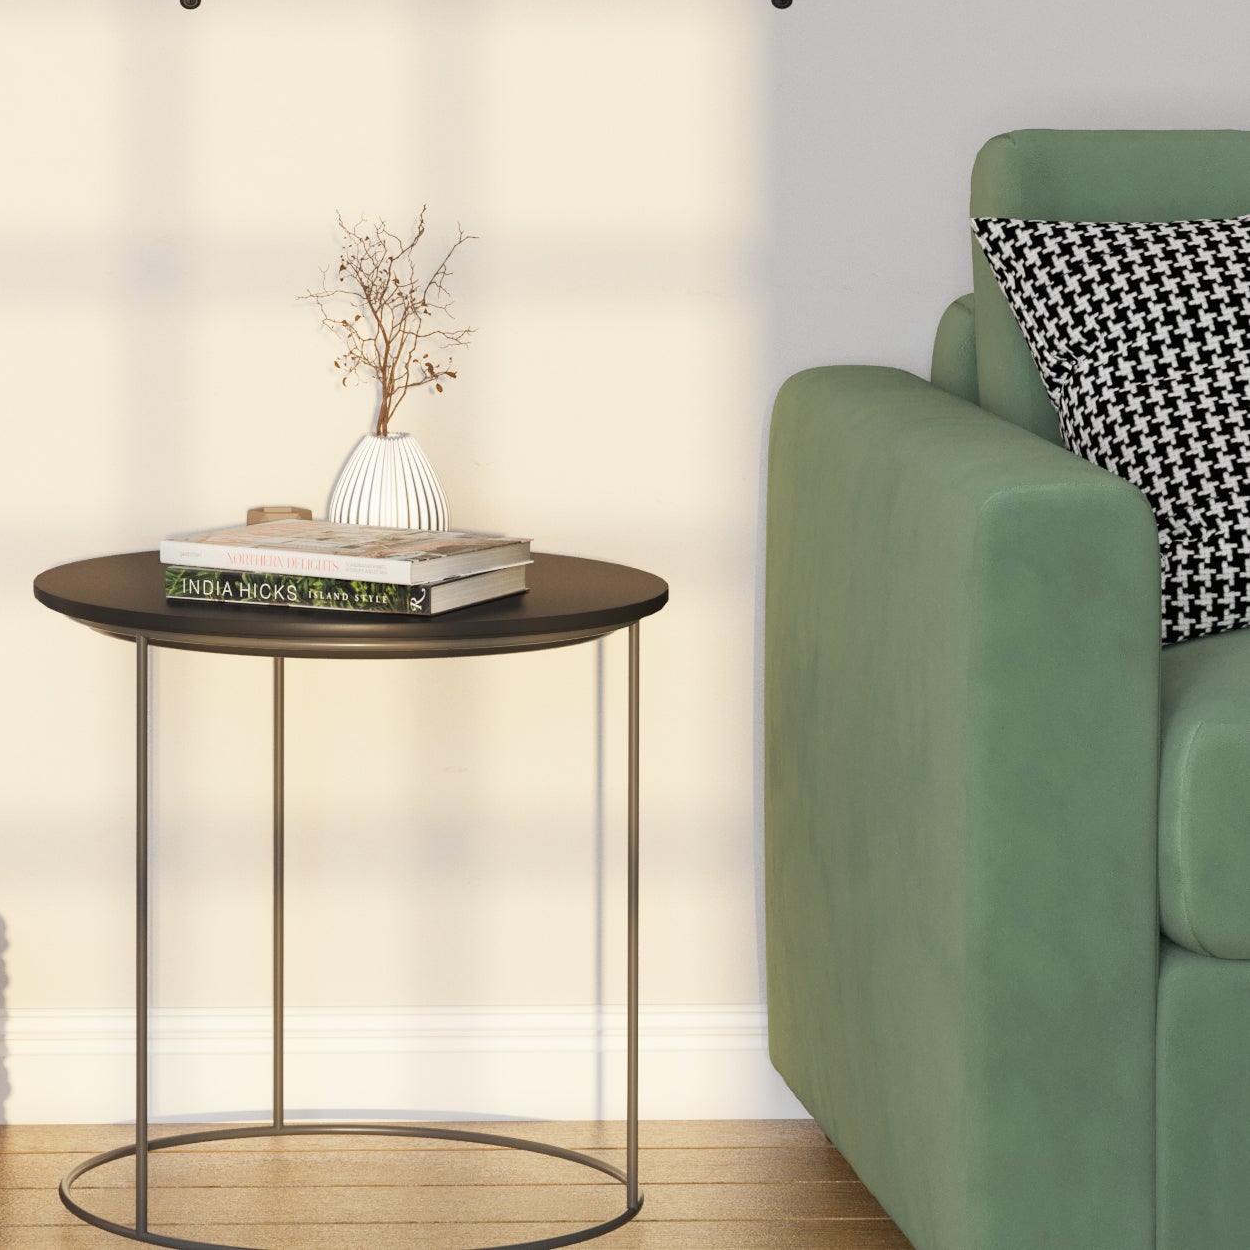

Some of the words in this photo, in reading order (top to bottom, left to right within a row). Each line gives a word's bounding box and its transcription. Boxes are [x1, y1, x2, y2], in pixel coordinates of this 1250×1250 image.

[226, 551, 284, 568] NORTHERN
[286, 556, 340, 572] DELIGHTS
[182, 578, 233, 598] INDIA
[239, 582, 298, 602] HICKS
[308, 591, 349, 603] ISLAND
[354, 593, 388, 604] STYLE
